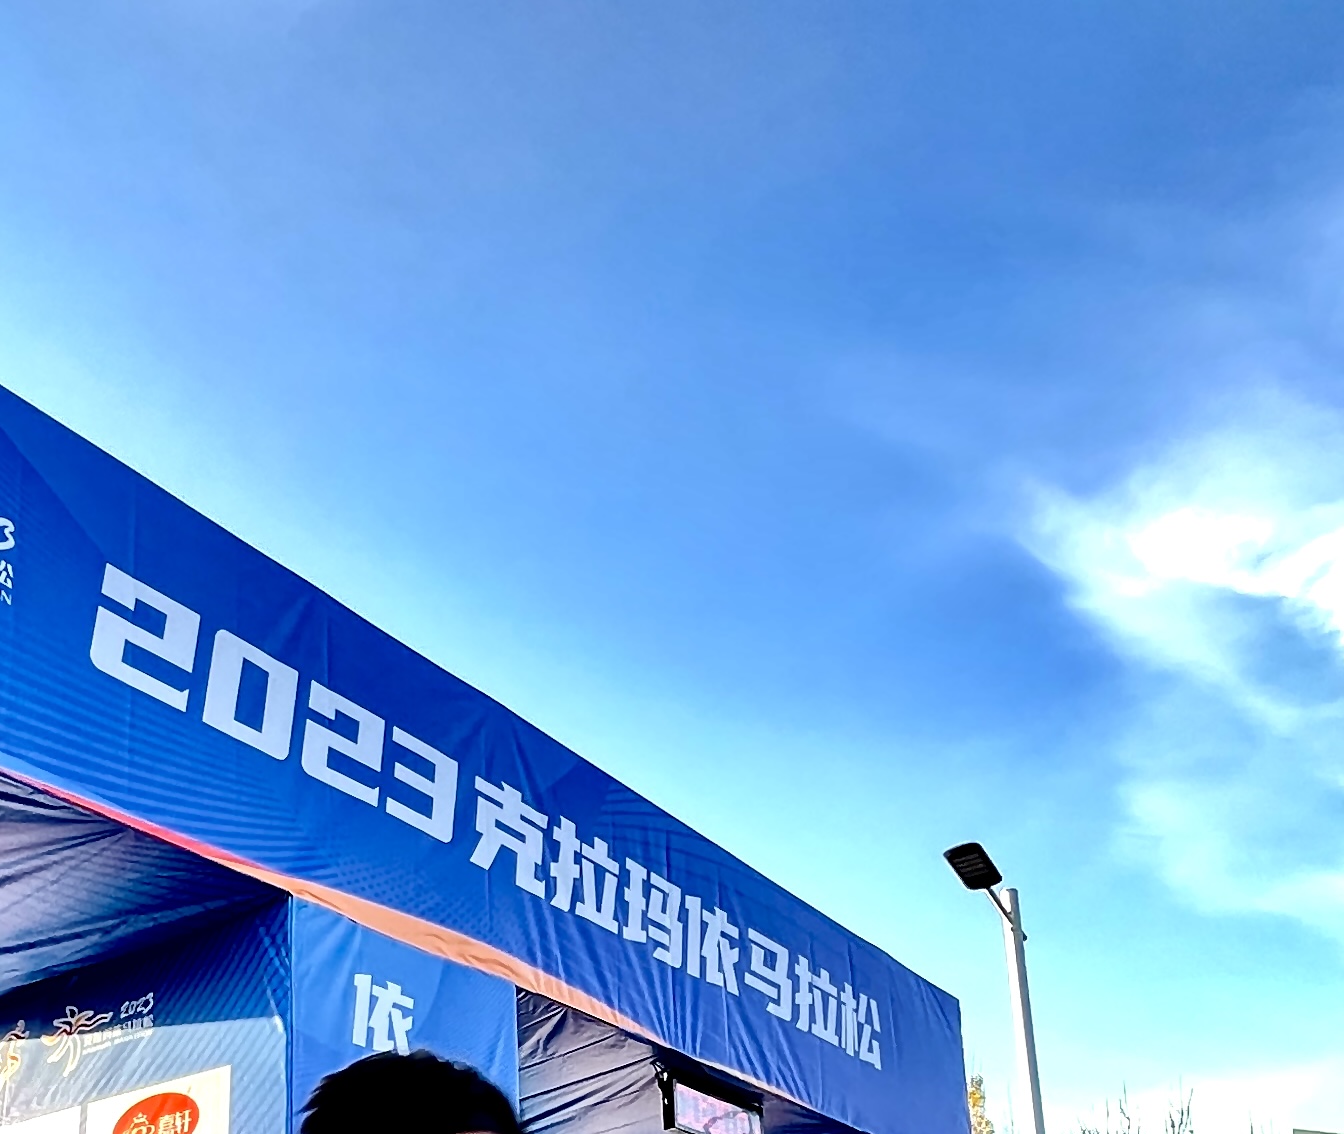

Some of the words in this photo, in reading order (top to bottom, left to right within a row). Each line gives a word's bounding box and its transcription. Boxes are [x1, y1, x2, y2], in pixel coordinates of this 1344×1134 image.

[90, 563, 459, 844] 2023
[469, 774, 883, 1071] 克拉玛依马拉松
[352, 973, 415, 1056] 依
